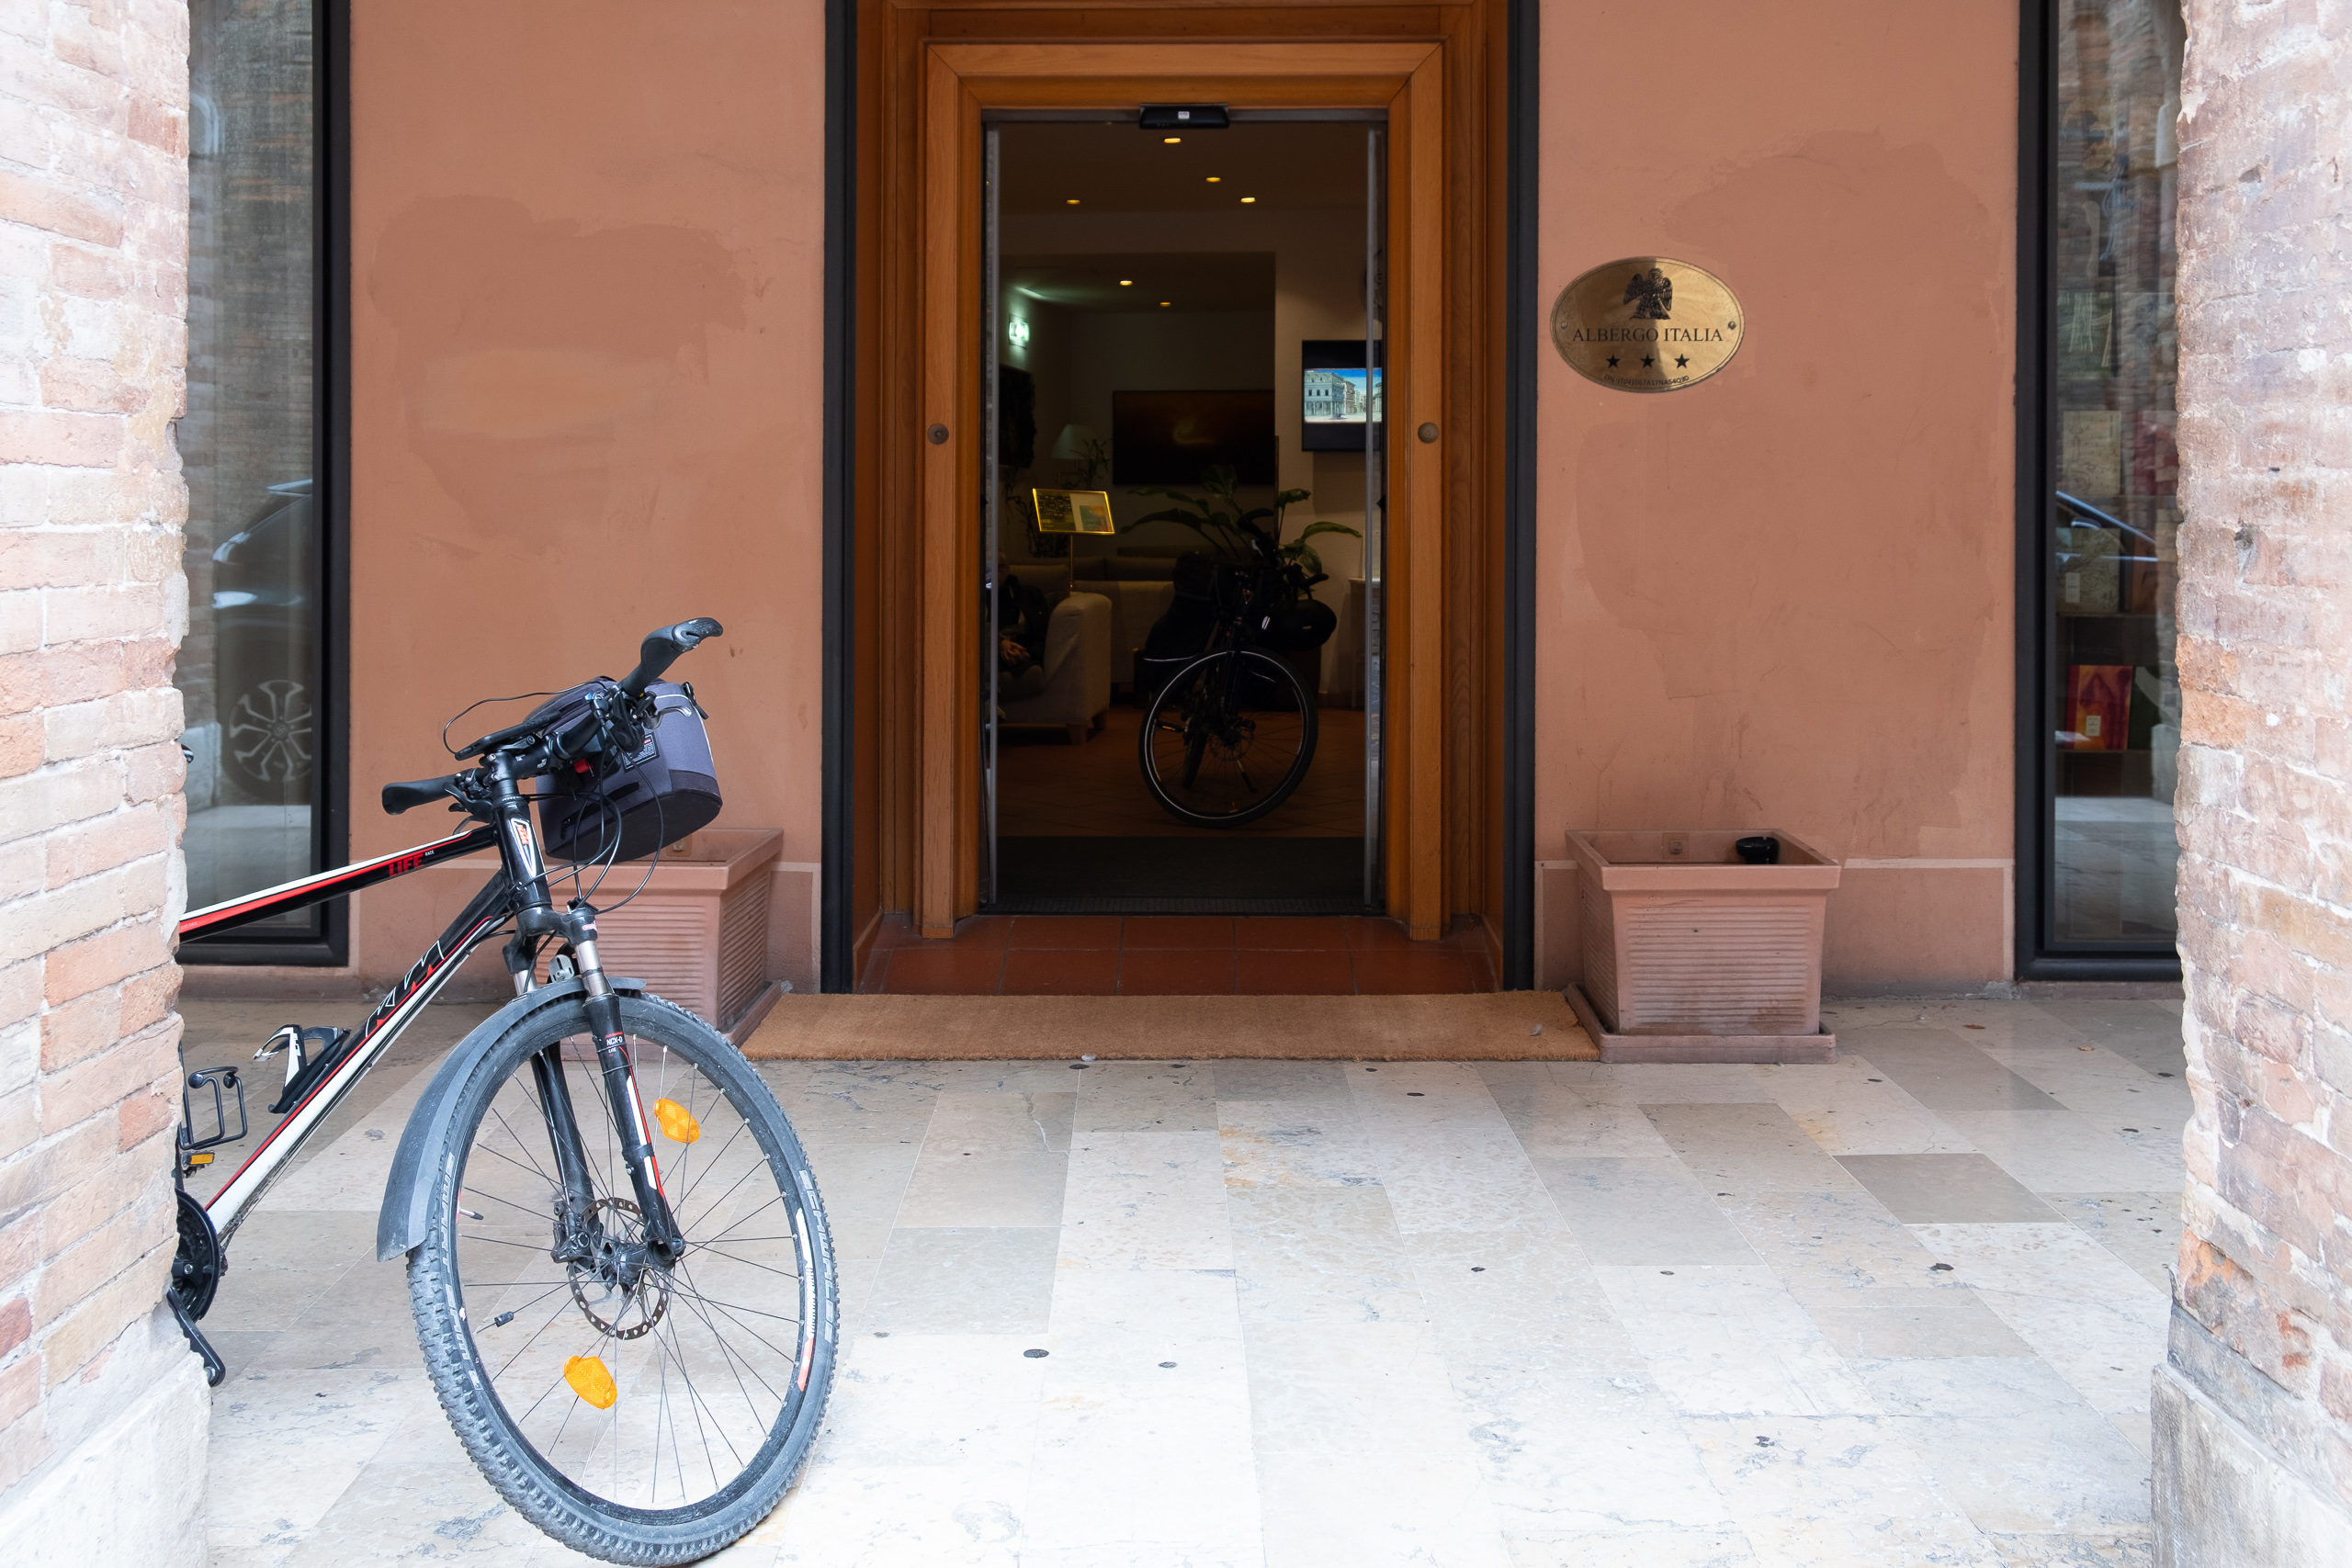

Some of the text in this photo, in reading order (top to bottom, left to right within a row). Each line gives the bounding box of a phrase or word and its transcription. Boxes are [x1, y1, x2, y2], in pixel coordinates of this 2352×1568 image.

[1573, 328, 1723, 342] ALBERGO ITALIA
[389, 853, 424, 877] LIFE
[606, 1035, 623, 1046] NCX-D
[798, 1169, 835, 1344] SCHWALBE
